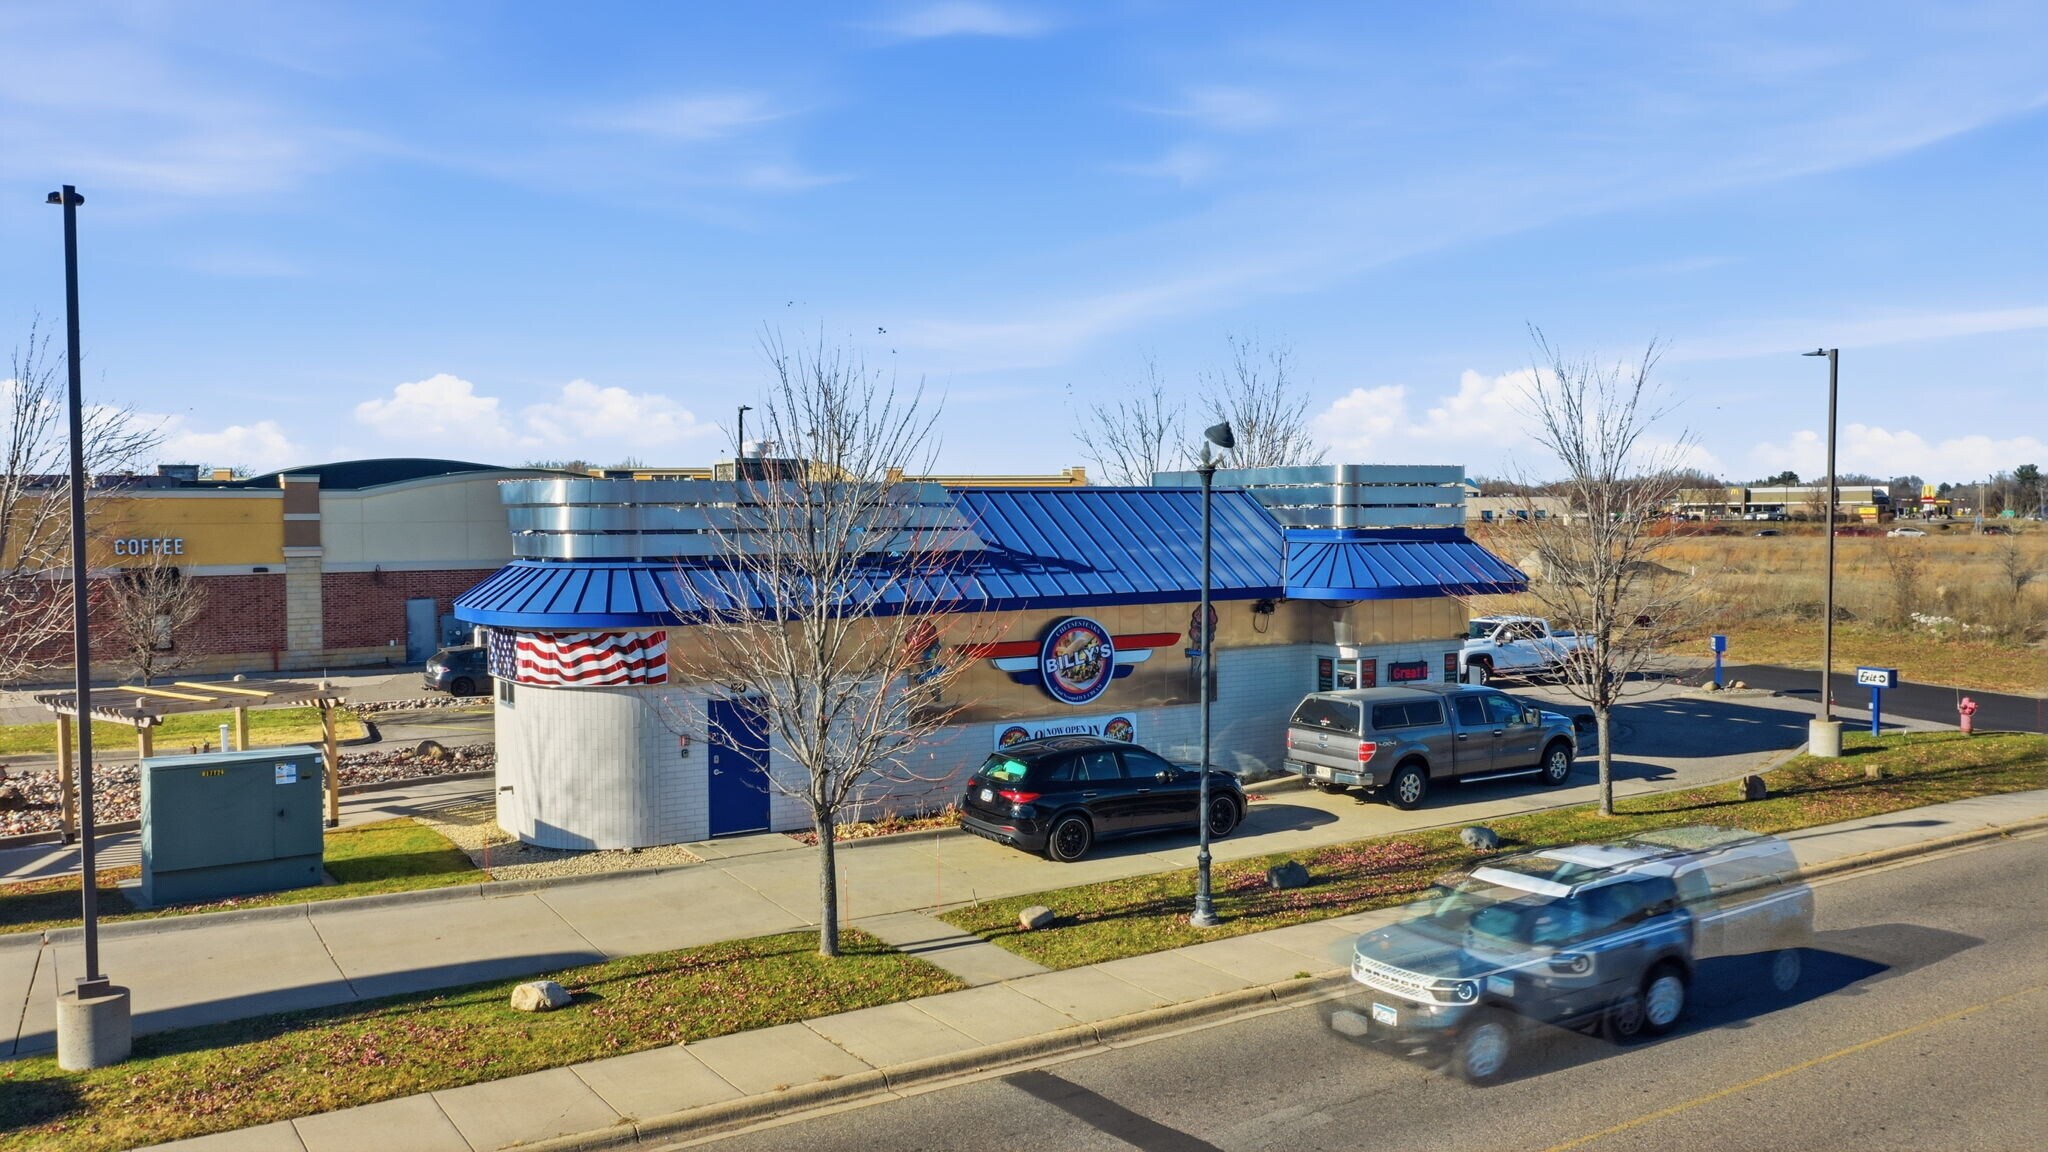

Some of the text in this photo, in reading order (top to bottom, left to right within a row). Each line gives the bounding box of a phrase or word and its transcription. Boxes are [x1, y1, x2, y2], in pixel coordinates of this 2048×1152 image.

[114, 538, 184, 555] COFFEE
[1045, 643, 1111, 674] BILLY'S
[1860, 671, 1877, 683] Exit
[1047, 727, 1064, 736] NOW
[1065, 725, 1087, 734] OPEN
